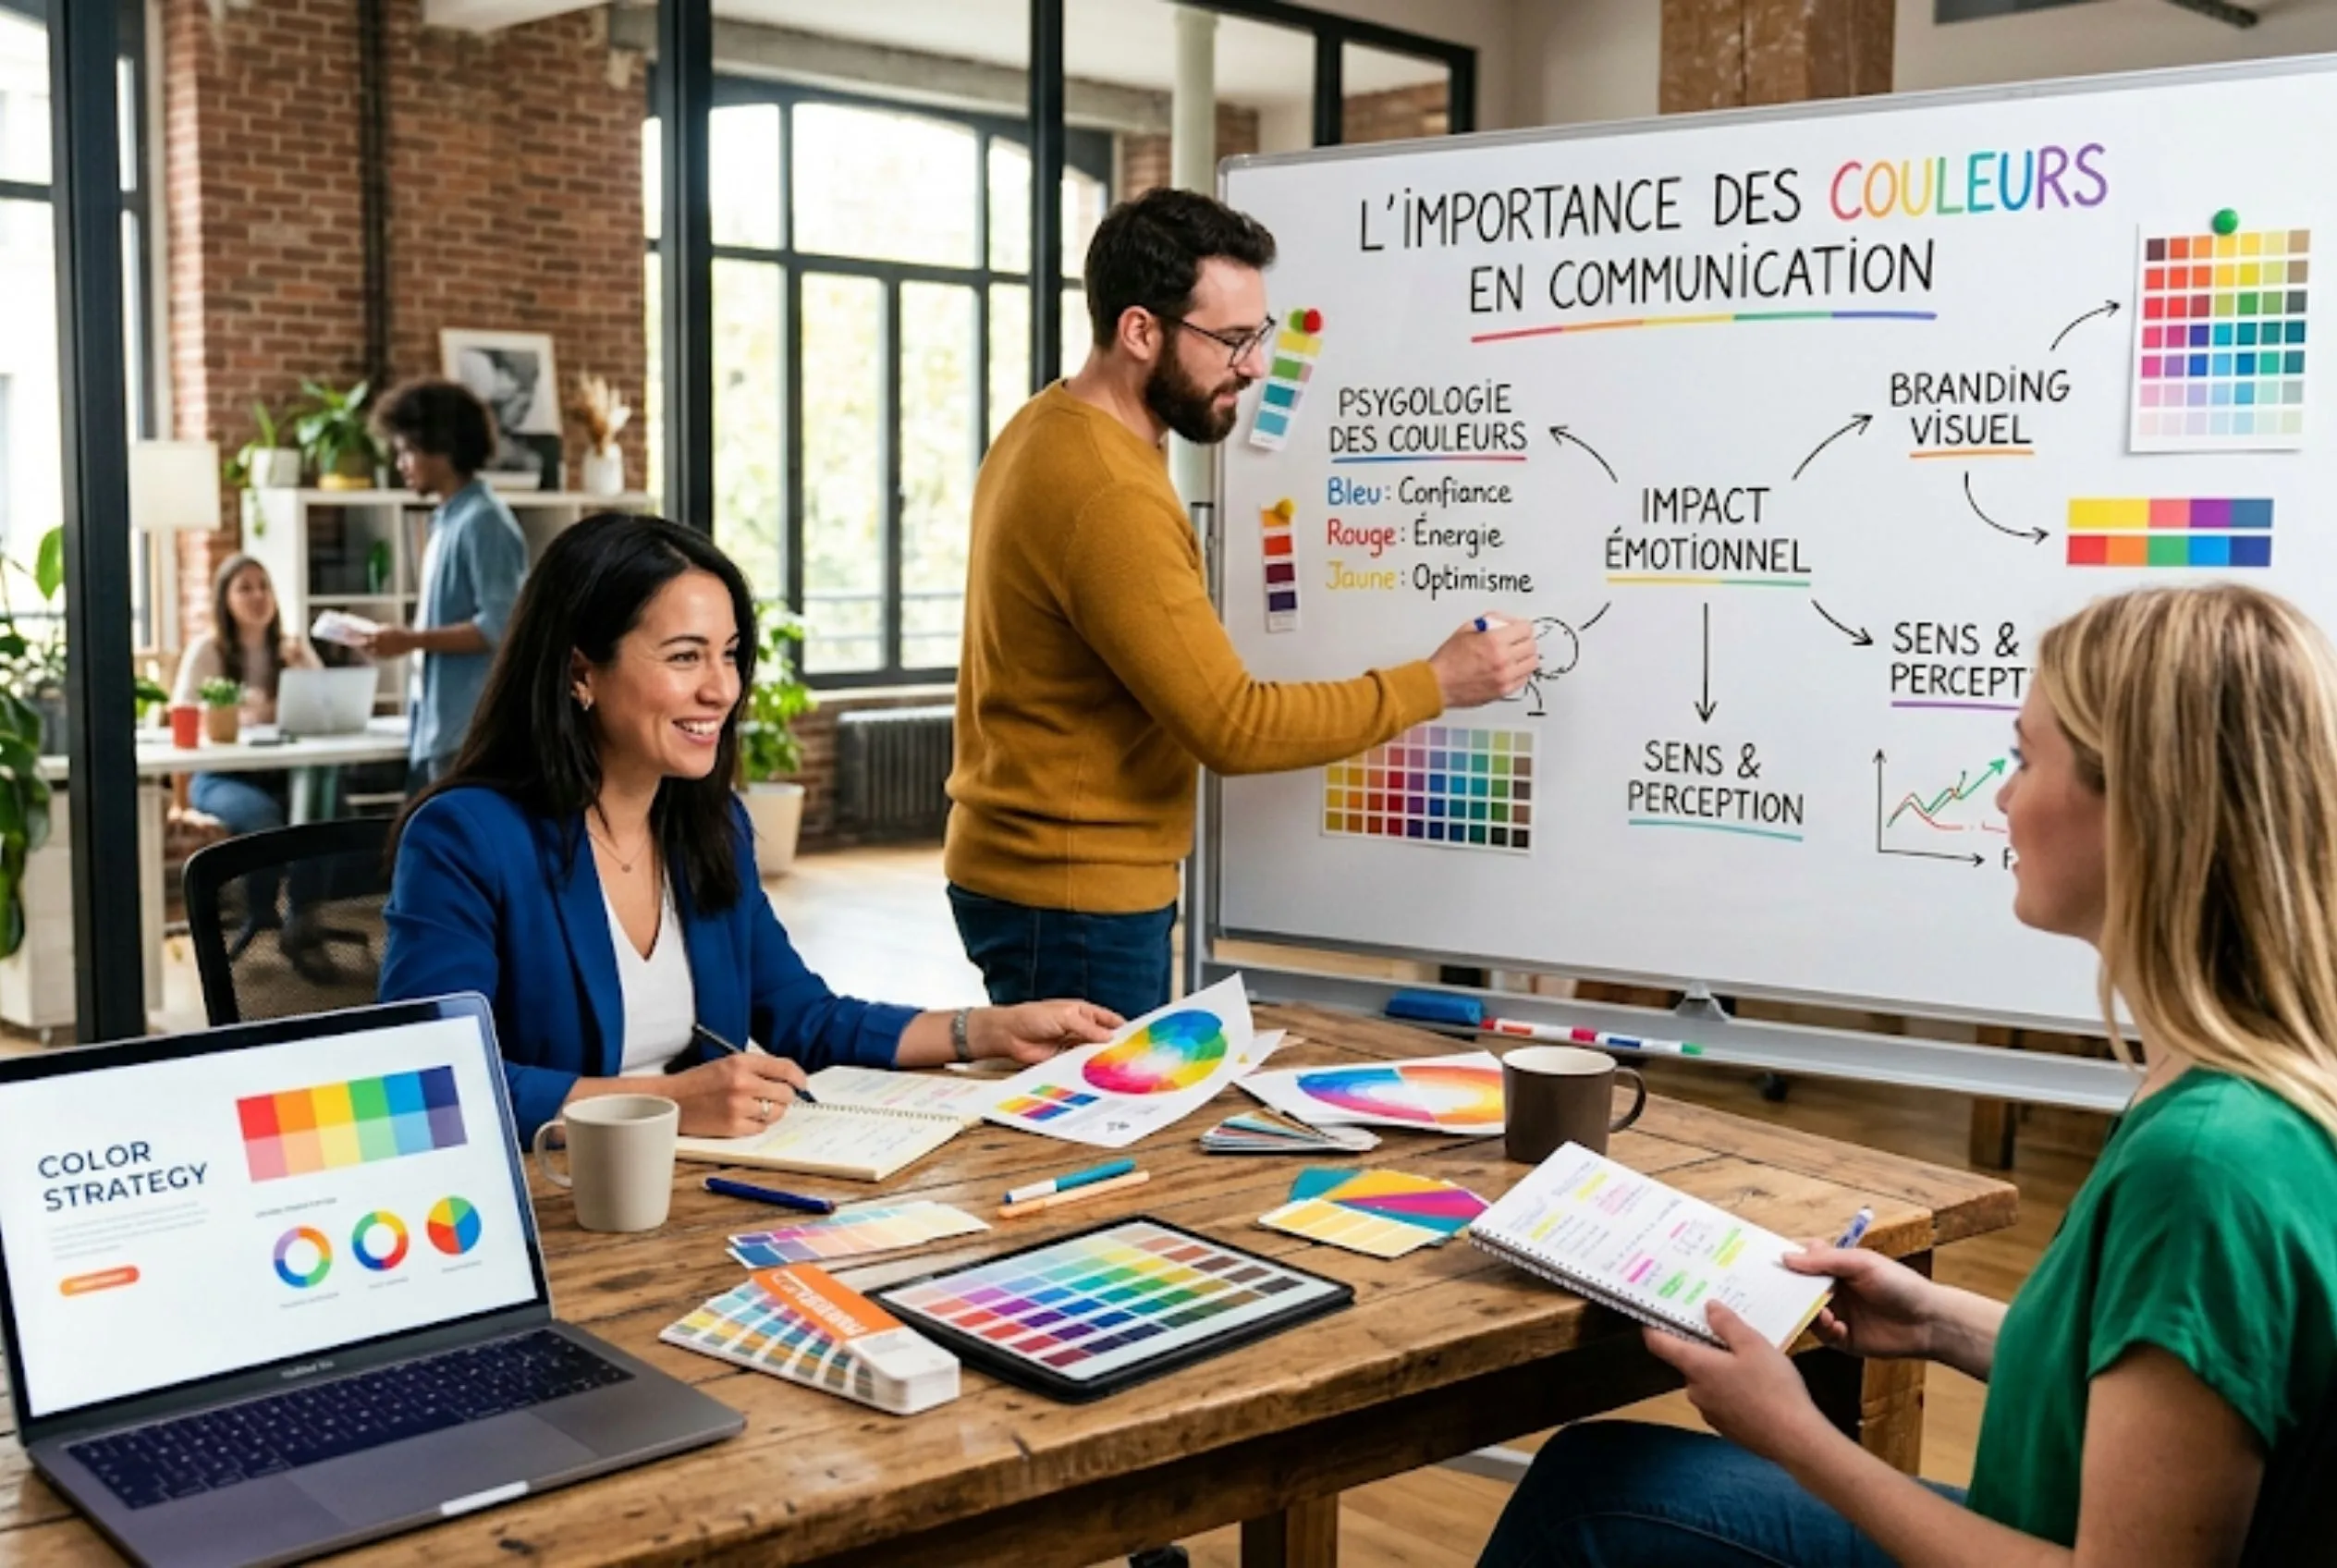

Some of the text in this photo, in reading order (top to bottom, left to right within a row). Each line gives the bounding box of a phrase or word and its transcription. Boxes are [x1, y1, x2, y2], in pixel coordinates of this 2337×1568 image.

[1361, 143, 2108, 252] L'IMPORTANCE DES COULEURS
[1470, 237, 1935, 313] EN COMMUNICATION
[1340, 379, 1511, 418] PSYGOLOGIE
[1890, 366, 2071, 407] BRANDING
[1330, 421, 1527, 453] DES COULEURS
[1910, 410, 2033, 445] VISUEL
[1399, 476, 1512, 510] Confiance
[1643, 485, 1771, 525] IMPACT
[1414, 511, 1504, 558] Énergie
[1606, 525, 1812, 572] ÉMOTIONNEL
[1413, 563, 1534, 601] Optimisme
[1892, 621, 2019, 657] SENS &
[1891, 662, 2030, 698] PERCEPT
[1645, 740, 1761, 779] SENS &
[1628, 779, 1804, 826] PERCEPTION
[38, 1141, 153, 1179] COLOR
[42, 1161, 208, 1211] STRATEGY
